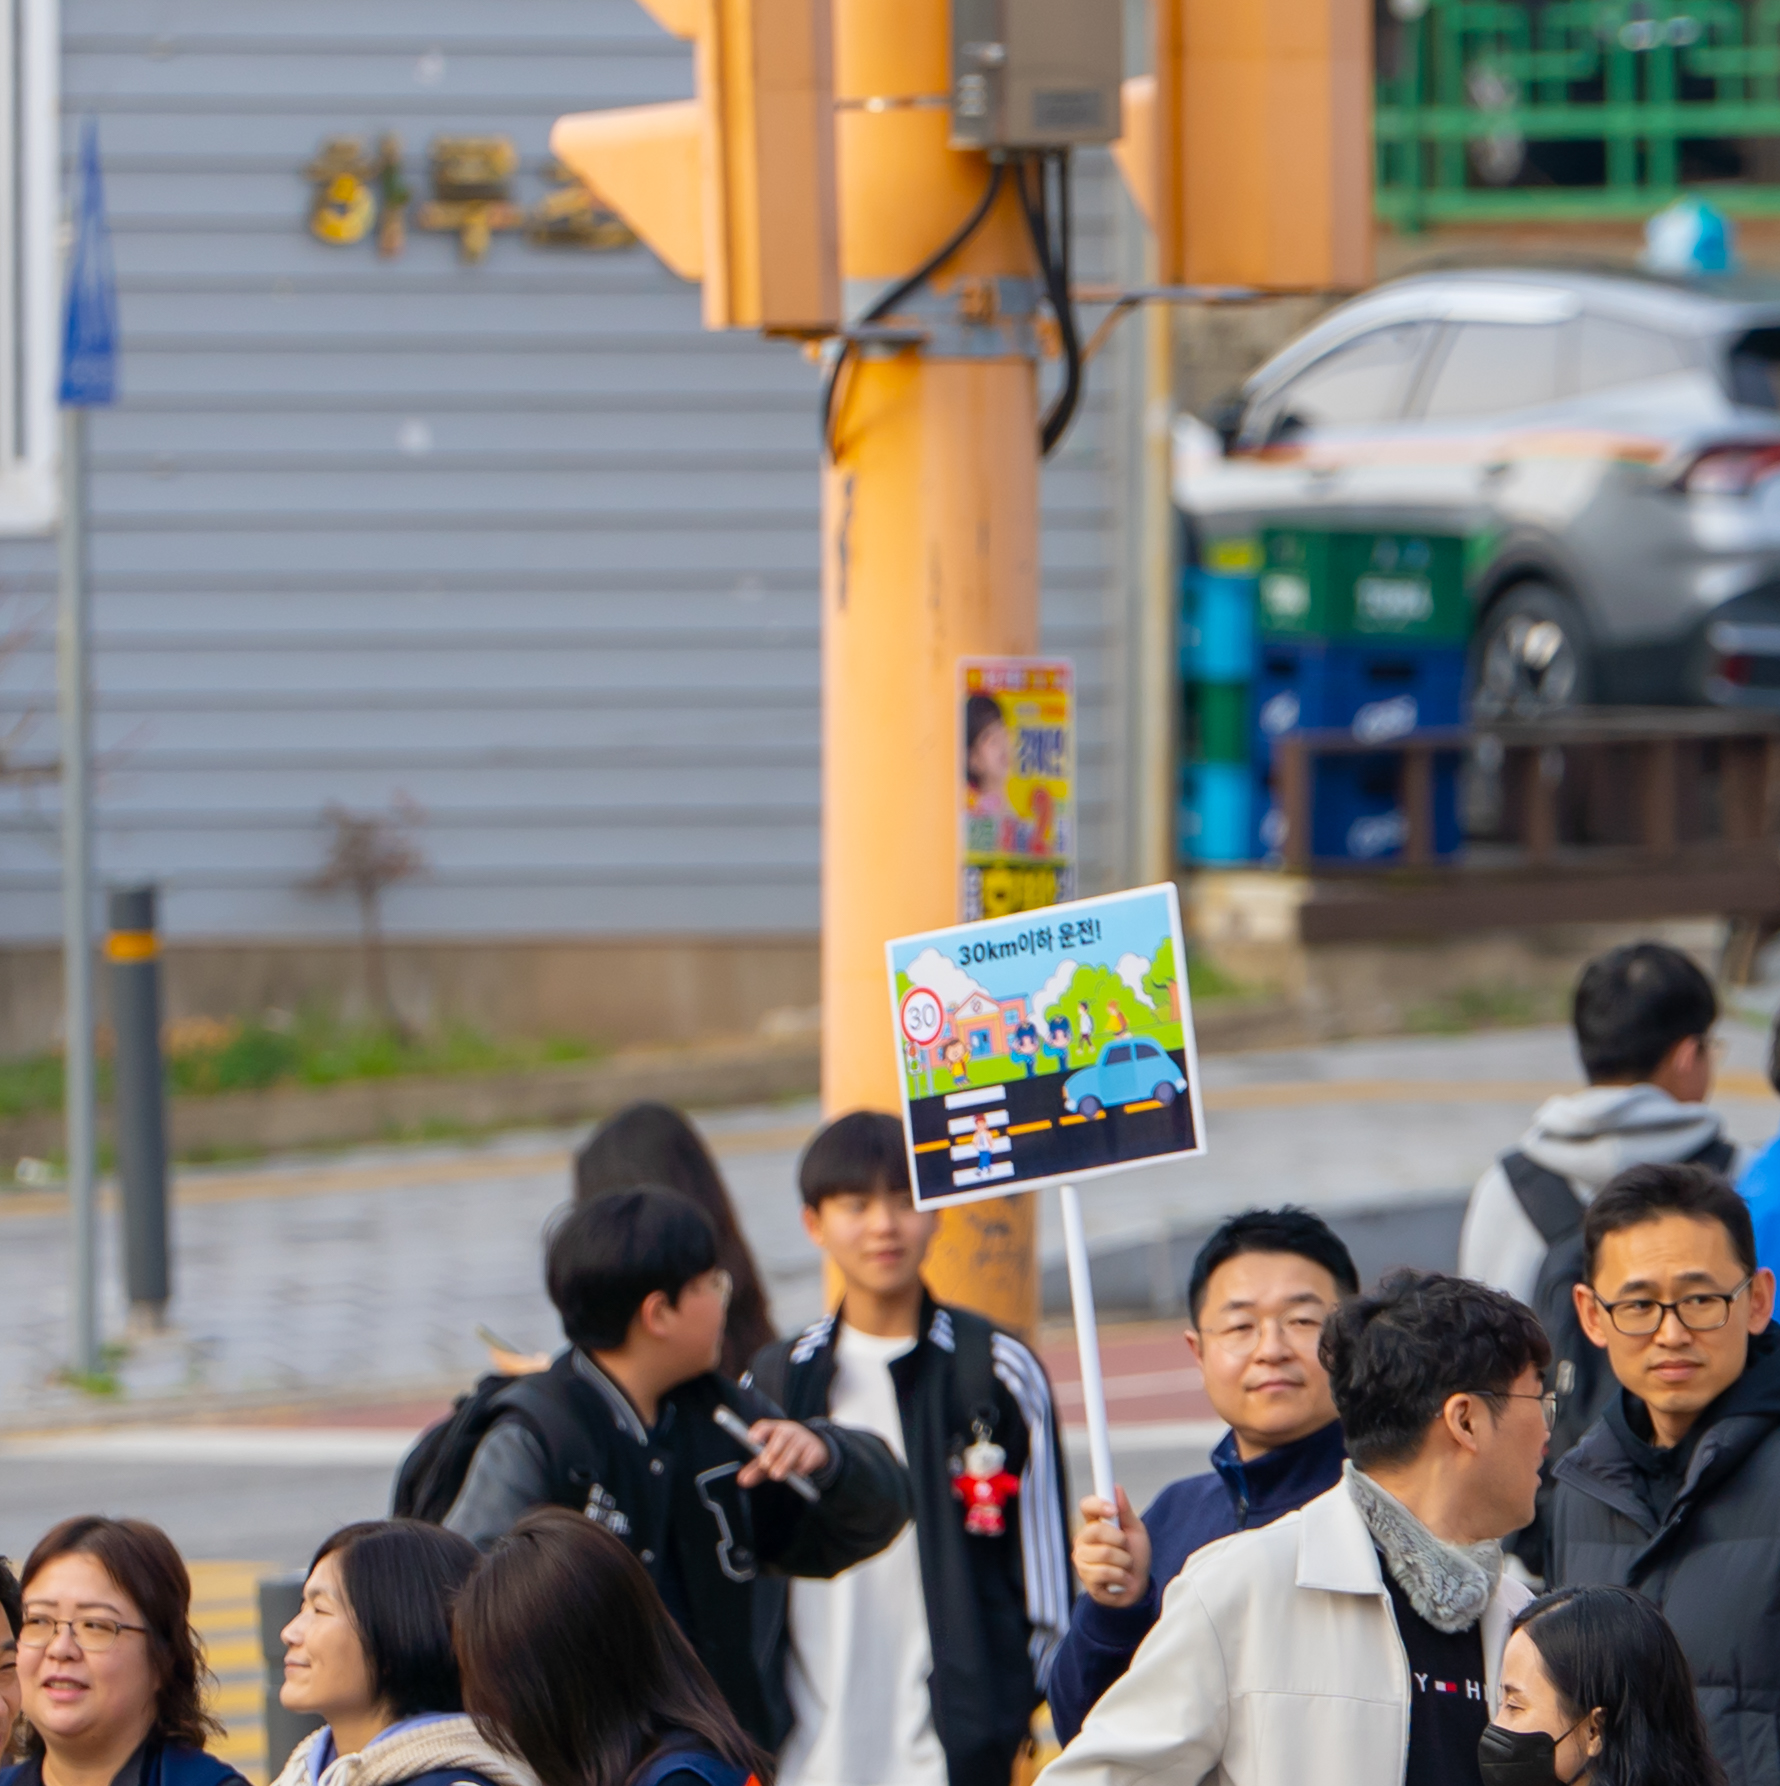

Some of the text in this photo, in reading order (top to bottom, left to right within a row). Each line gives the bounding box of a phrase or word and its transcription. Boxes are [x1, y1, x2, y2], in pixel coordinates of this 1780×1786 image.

[959, 917, 1103, 967] 30km이하 운전!
[906, 1002, 937, 1032] 30
